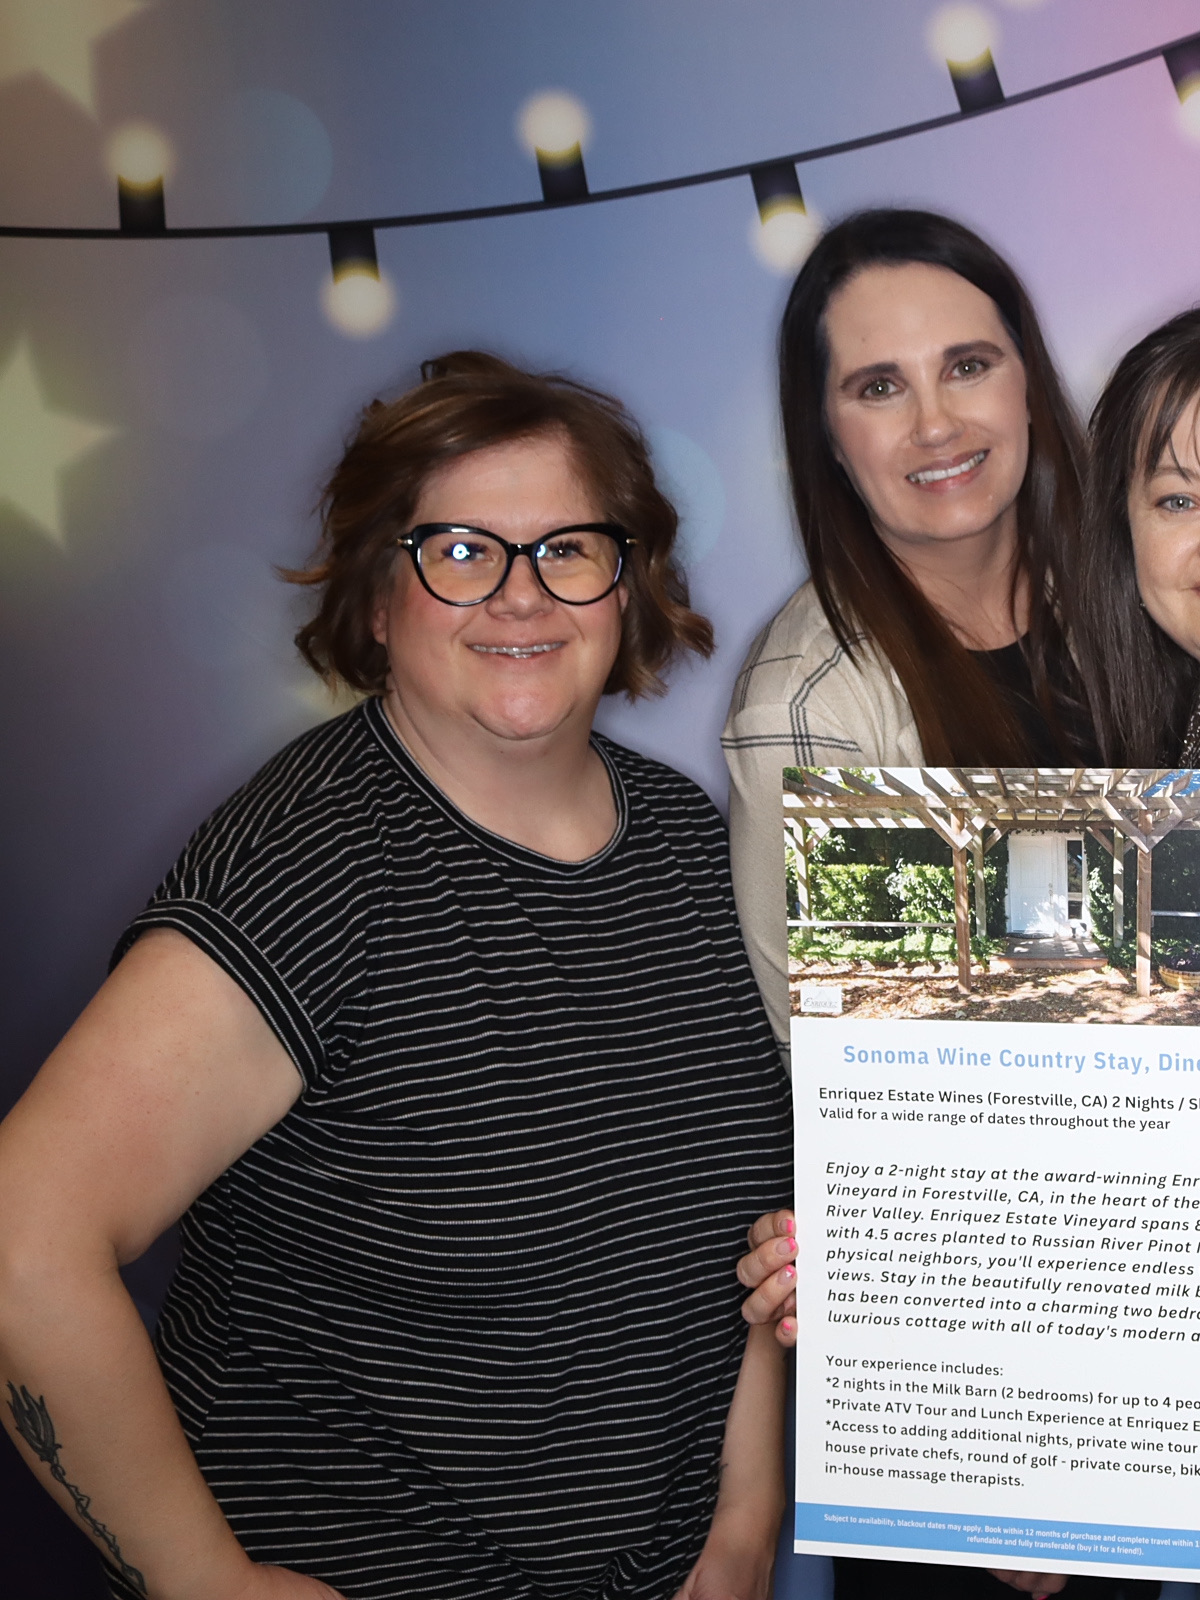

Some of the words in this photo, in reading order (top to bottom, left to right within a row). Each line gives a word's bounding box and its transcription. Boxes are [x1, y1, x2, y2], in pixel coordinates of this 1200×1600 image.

[843, 1045, 930, 1065] Sonoma
[936, 1047, 992, 1067] Wine
[999, 1049, 1086, 1074] Country
[1094, 1051, 1150, 1075] Stay,
[819, 1087, 884, 1103] Enriquez
[888, 1089, 934, 1102] Estate
[938, 1090, 983, 1104] Wines
[987, 1091, 1077, 1110] (Forestville,
[1081, 1095, 1108, 1109] CA)
[1112, 1096, 1120, 1108] 2
[1125, 1096, 1174, 1113] Nights
[1178, 1097, 1185, 1111] /
[819, 1107, 853, 1119] Valid
[857, 1108, 877, 1120] for
[880, 1111, 889, 1121] a
[891, 1109, 924, 1122] wide
[928, 1113, 966, 1126] range
[970, 1111, 984, 1124] of
[987, 1112, 1026, 1125] dates
[1029, 1114, 1109, 1130] throughout
[1112, 1116, 1136, 1129] the
[1139, 1120, 1171, 1132] year
[826, 1161, 870, 1179] Enjoy
[874, 1166, 884, 1176] a
[888, 1164, 946, 1181] 2-night
[950, 1167, 986, 1183] stay
[990, 1169, 1008, 1180] at
[1013, 1168, 1039, 1181] the
[1044, 1170, 1167, 1190] award-winning
[827, 1183, 898, 1200] Vineyard
[902, 1185, 917, 1199] in
[922, 1187, 1011, 1205] Forestville,
[1018, 1190, 1044, 1206] CA,
[1050, 1191, 1065, 1204] in
[1070, 1192, 1097, 1205] the
[1101, 1193, 1147, 1207] heart
[1152, 1195, 1170, 1208] of
[1174, 1196, 1200, 1210] the
[826, 1204, 867, 1218] River
[872, 1206, 924, 1224] Valley.
[930, 1209, 1001, 1226] Enriquez
[1005, 1211, 1057, 1226] Estate
[1063, 1214, 1137, 1231] Vineyard
[1141, 1219, 1189, 1233] spans
[826, 1247, 894, 1263] physical
[898, 1251, 982, 1269] neighbors,
[986, 1255, 1033, 1270] you'll
[1037, 1258, 1127, 1273] experience
[1132, 1261, 1194, 1276] endless
[827, 1268, 874, 1282] views.
[880, 1270, 917, 1287] Stay
[921, 1272, 936, 1285] in
[941, 1273, 967, 1287] the
[971, 1274, 1062, 1294] beautifully
[1066, 1282, 1151, 1295] renovated
[1155, 1284, 1190, 1297] milk
[828, 1310, 900, 1326] luxurious
[905, 1316, 967, 1333] cottage
[972, 1318, 1005, 1332] with
[1010, 1320, 1032, 1333] all
[1036, 1321, 1054, 1334] of
[1058, 1323, 1117, 1340] today's
[1122, 1327, 1186, 1341] modern
[825, 1355, 858, 1367] Your
[861, 1358, 937, 1373] experience
[941, 1361, 1003, 1376] includes:
[884, 1402, 912, 1414] ATV
[915, 1403, 948, 1416] Tour
[951, 1406, 976, 1418] and
[981, 1407, 1023, 1421] Lunch
[1027, 1410, 1105, 1426] Experience
[1108, 1416, 1122, 1427] at
[1127, 1416, 1189, 1433] Enriquez
[882, 1424, 897, 1435] to
[900, 1424, 948, 1441] adding
[951, 1428, 1022, 1443] additional
[1026, 1432, 1073, 1449] nights,
[1077, 1435, 1127, 1450] private
[1130, 1439, 1164, 1452] wine
[1167, 1442, 1198, 1454] tour
[825, 1461, 884, 1477] in-house
[888, 1469, 947, 1484] massage
[950, 1470, 1024, 1488] therapists.
[824, 1514, 849, 1523] Subject
[858, 1517, 896, 1527] availability,
[897, 1519, 926, 1528] blackout
[927, 1521, 946, 1530] dates
[947, 1524, 962, 1532] may
[962, 1525, 982, 1534] apply.
[984, 1525, 1002, 1534] Book
[1002, 1527, 1024, 1535] within
[1025, 1528, 1034, 1536] 12
[1035, 1530, 1061, 1538] months
[1061, 1531, 1069, 1539] of
[1070, 1533, 1102, 1541] purchase
[1103, 1534, 1116, 1542] and
[1117, 1536, 1150, 1545] complete
[1150, 1538, 1171, 1546] travel
[1171, 1539, 1194, 1547] within
[966, 1535, 1003, 1545] refundable
[1018, 1539, 1033, 1549] fully
[1034, 1541, 1076, 1550] transferable
[1076, 1543, 1092, 1553] (buy
[1093, 1544, 1099, 1552] it
[1099, 1545, 1110, 1553] for
